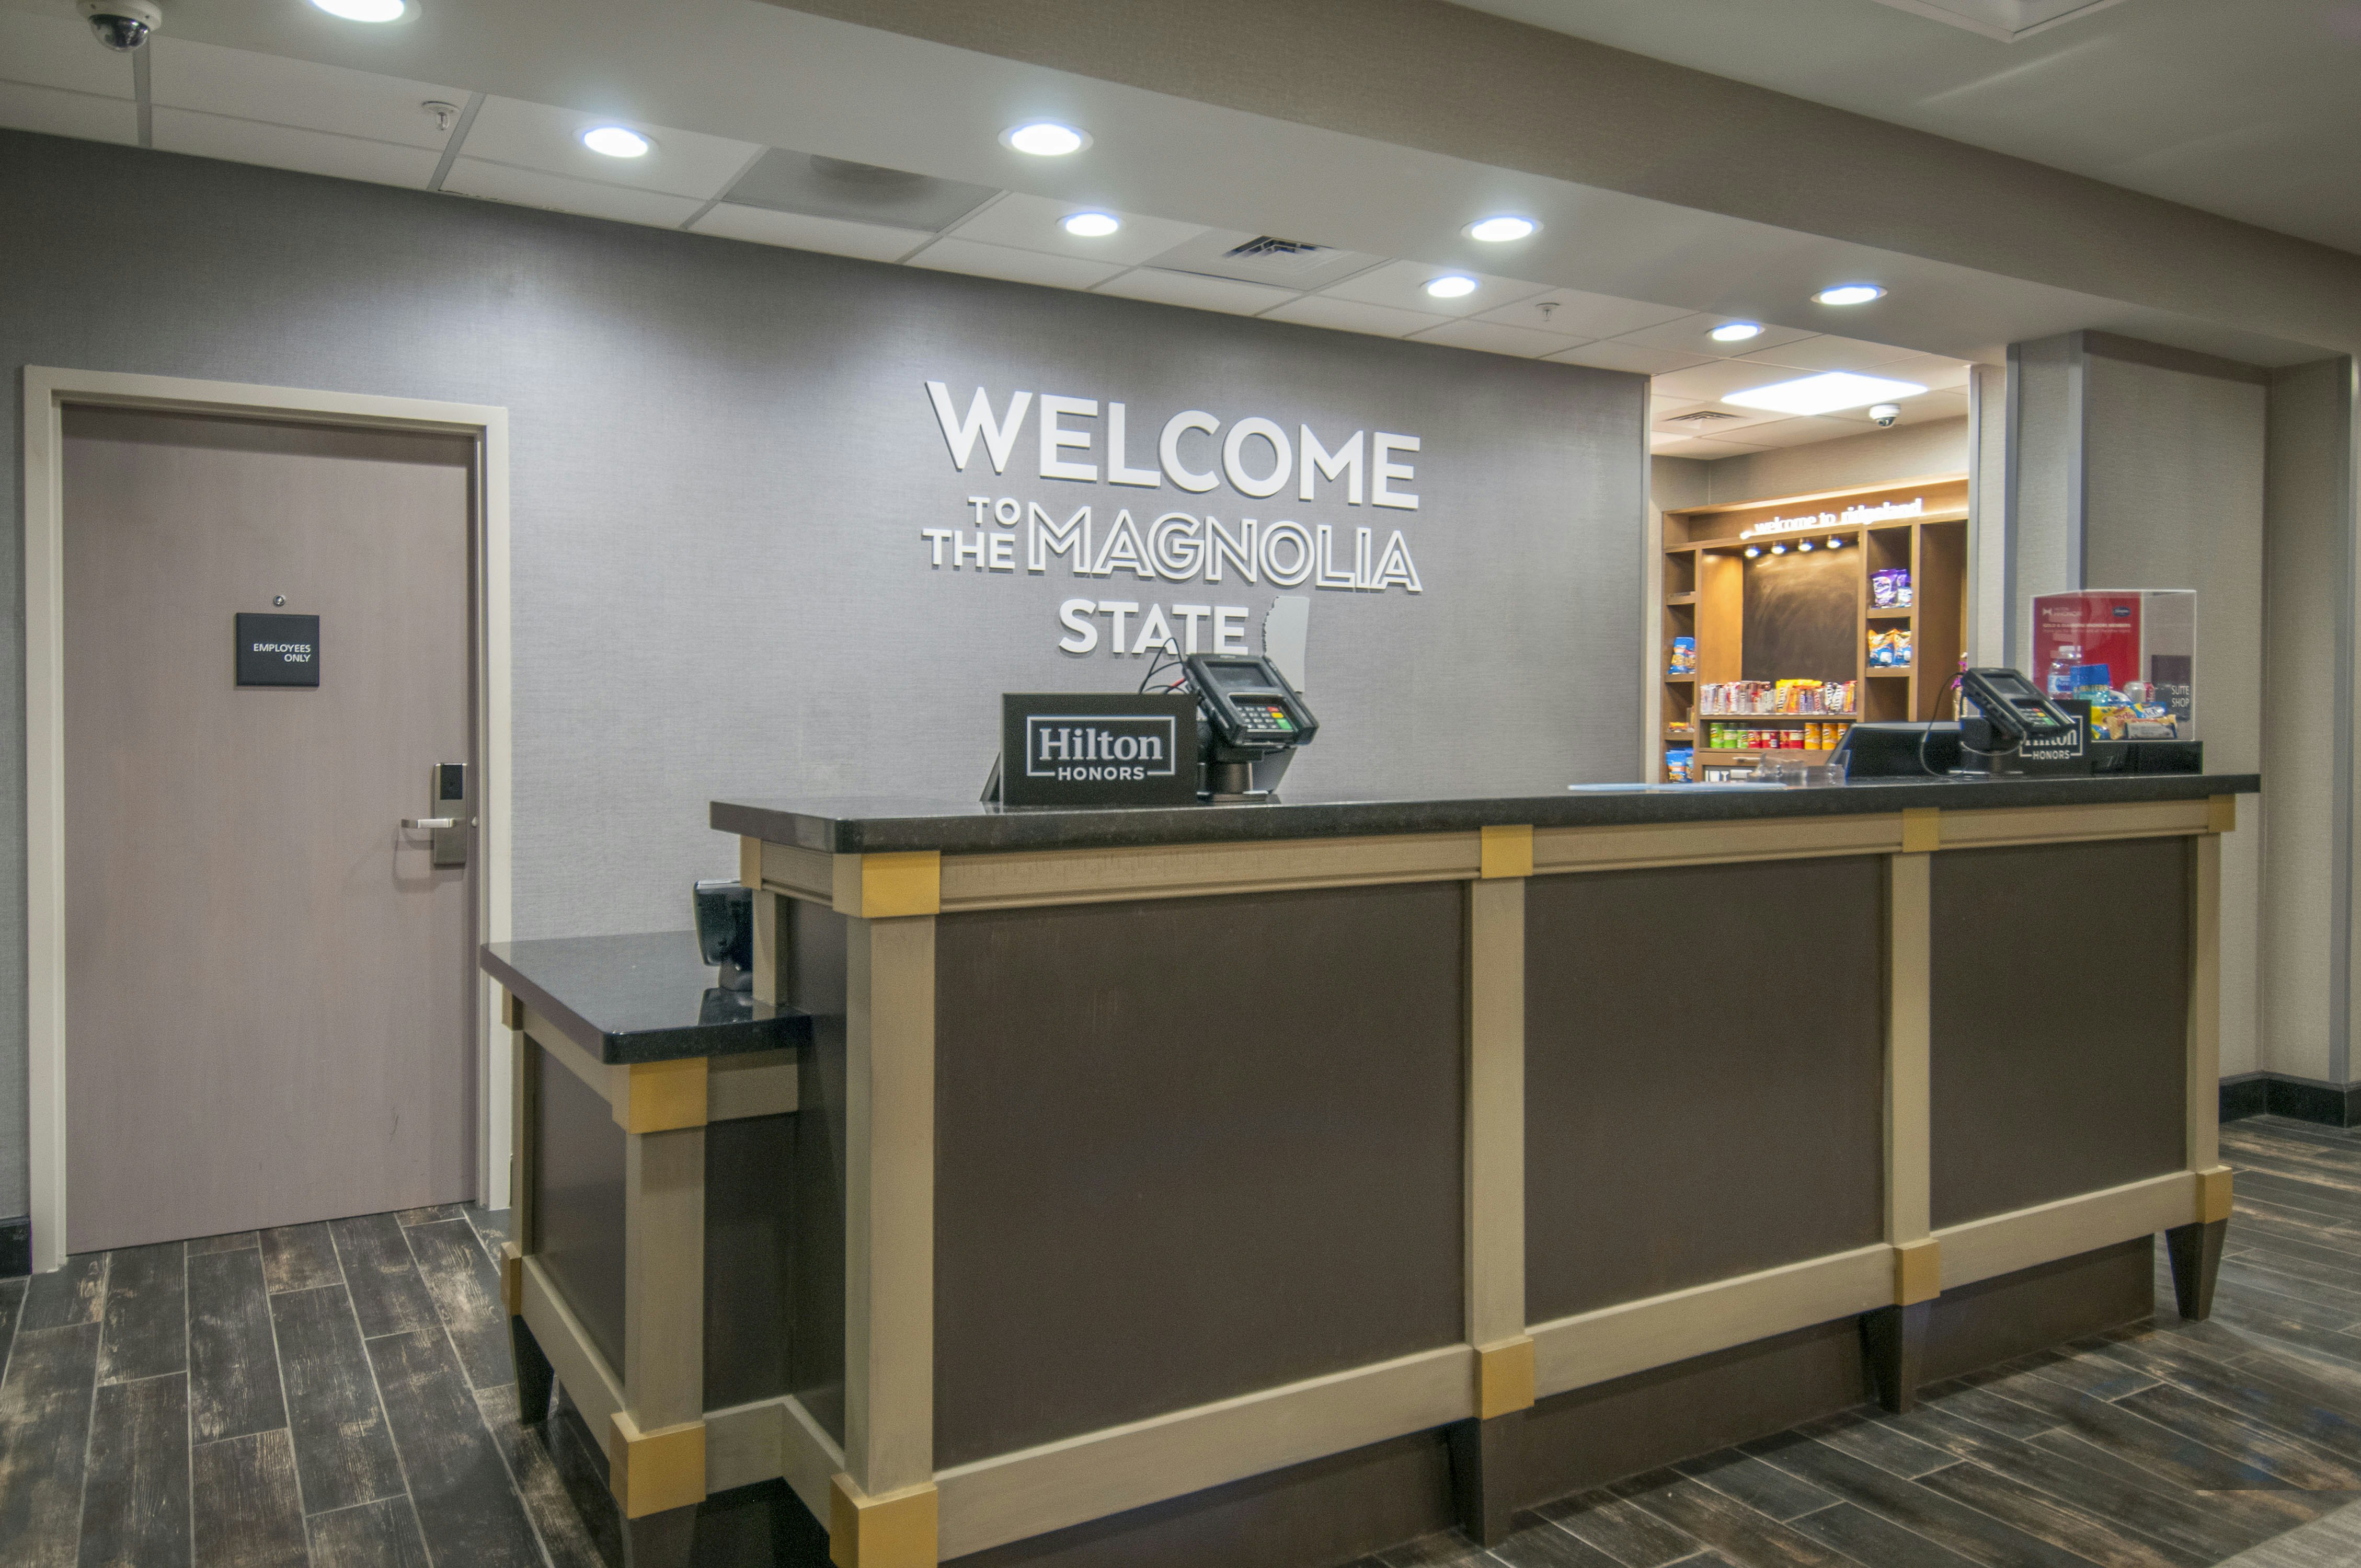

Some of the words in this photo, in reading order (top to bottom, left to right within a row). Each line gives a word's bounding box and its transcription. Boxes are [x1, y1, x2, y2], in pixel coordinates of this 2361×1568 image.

[925, 381, 1420, 510] WELCOME
[968, 495, 1021, 526] TO
[1754, 516, 1817, 533] welcome
[1819, 512, 1836, 525] to
[923, 528, 1015, 569] THE
[1028, 501, 1423, 592] MAGNOLIA
[1059, 598, 1250, 655] STATE
[254, 643, 311, 653] EMPLOYEES
[284, 654, 311, 662] ONLY
[2171, 685, 2190, 695] SUITE
[2171, 698, 2190, 707] SHOP
[1039, 728, 1163, 760] Hilton
[2032, 750, 2070, 759] HONORS
[1058, 766, 1145, 781] HONORS
